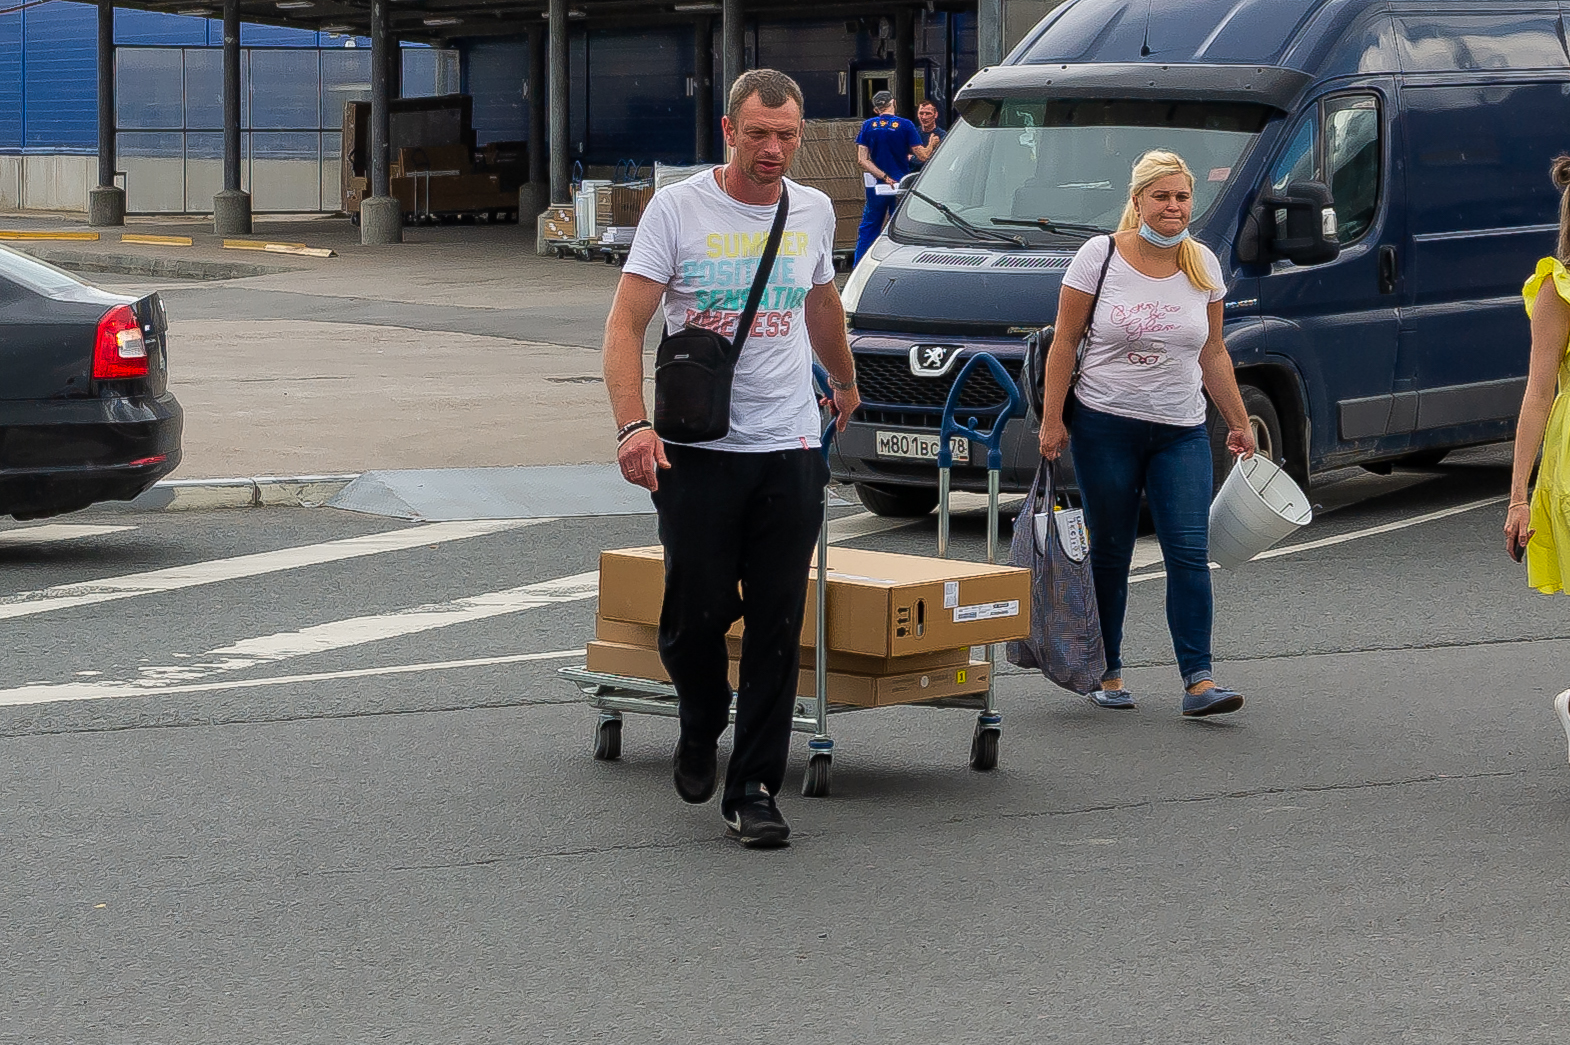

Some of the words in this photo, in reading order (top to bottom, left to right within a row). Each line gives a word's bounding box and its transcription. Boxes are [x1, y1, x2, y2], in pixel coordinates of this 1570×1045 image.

[696, 287, 809, 311] SENSATIO
[684, 308, 792, 337] TIMEESS
[880, 435, 967, 456] М801ВС78
